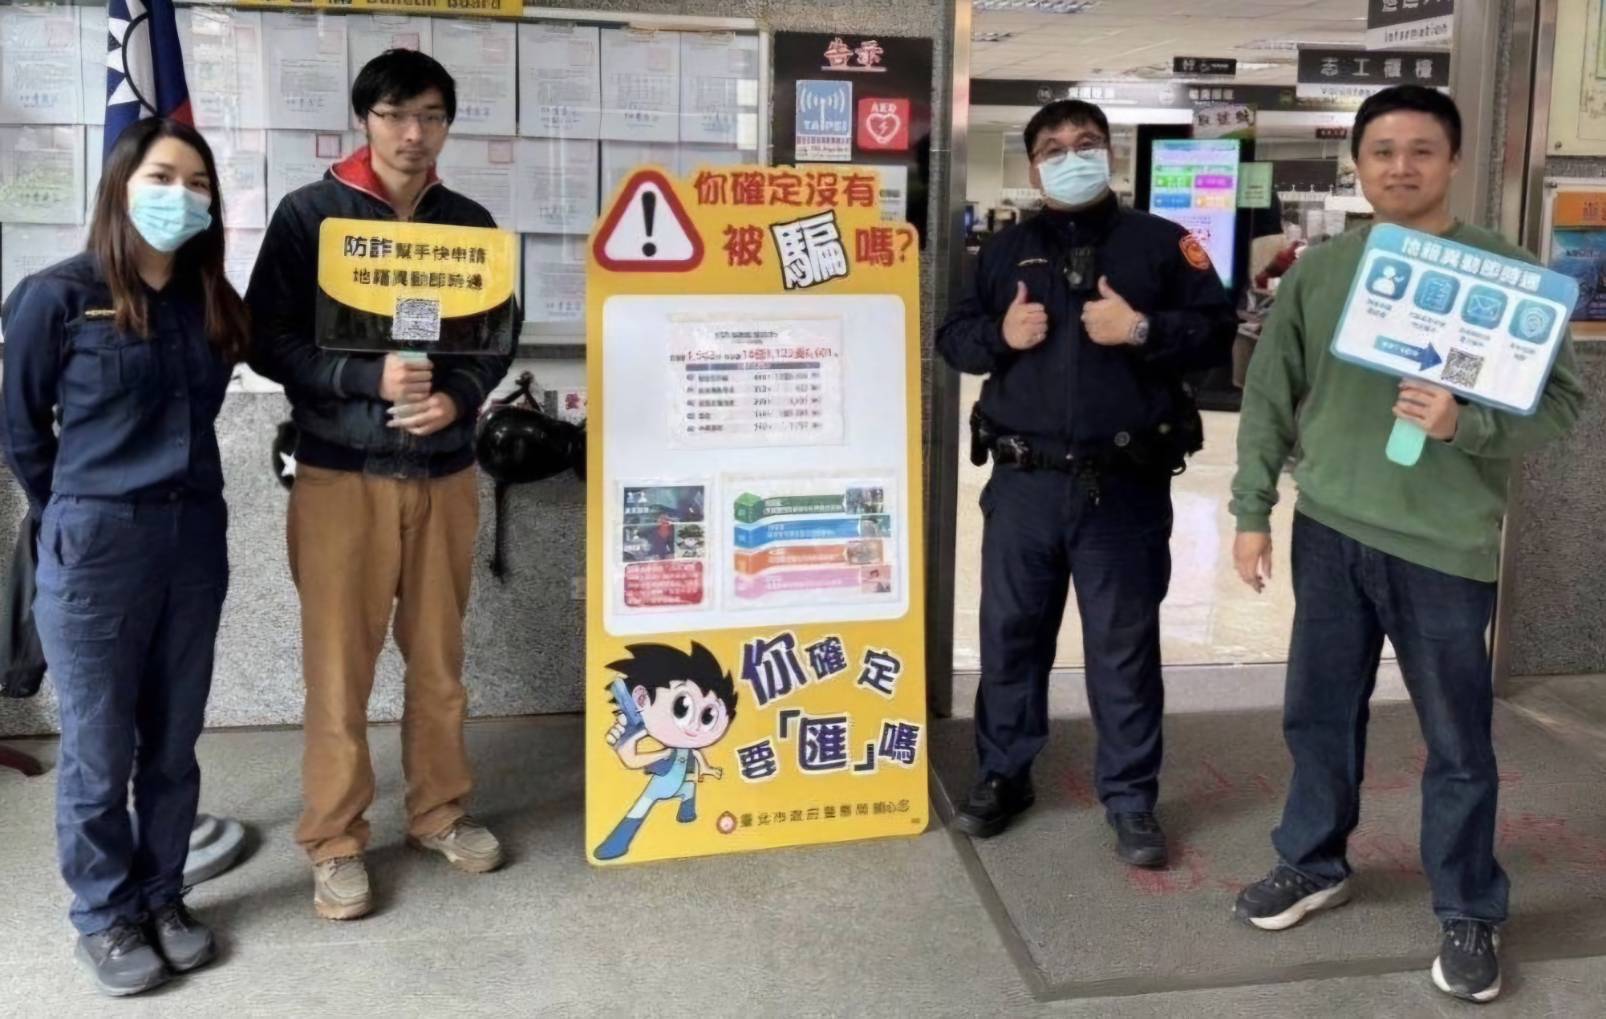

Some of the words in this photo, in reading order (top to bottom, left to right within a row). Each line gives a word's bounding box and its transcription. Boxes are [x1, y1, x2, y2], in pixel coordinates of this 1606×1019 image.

[870, 102, 897, 113] AED
[803, 120, 848, 131] TAIPEI
[694, 170, 876, 208] 你確定沒有
